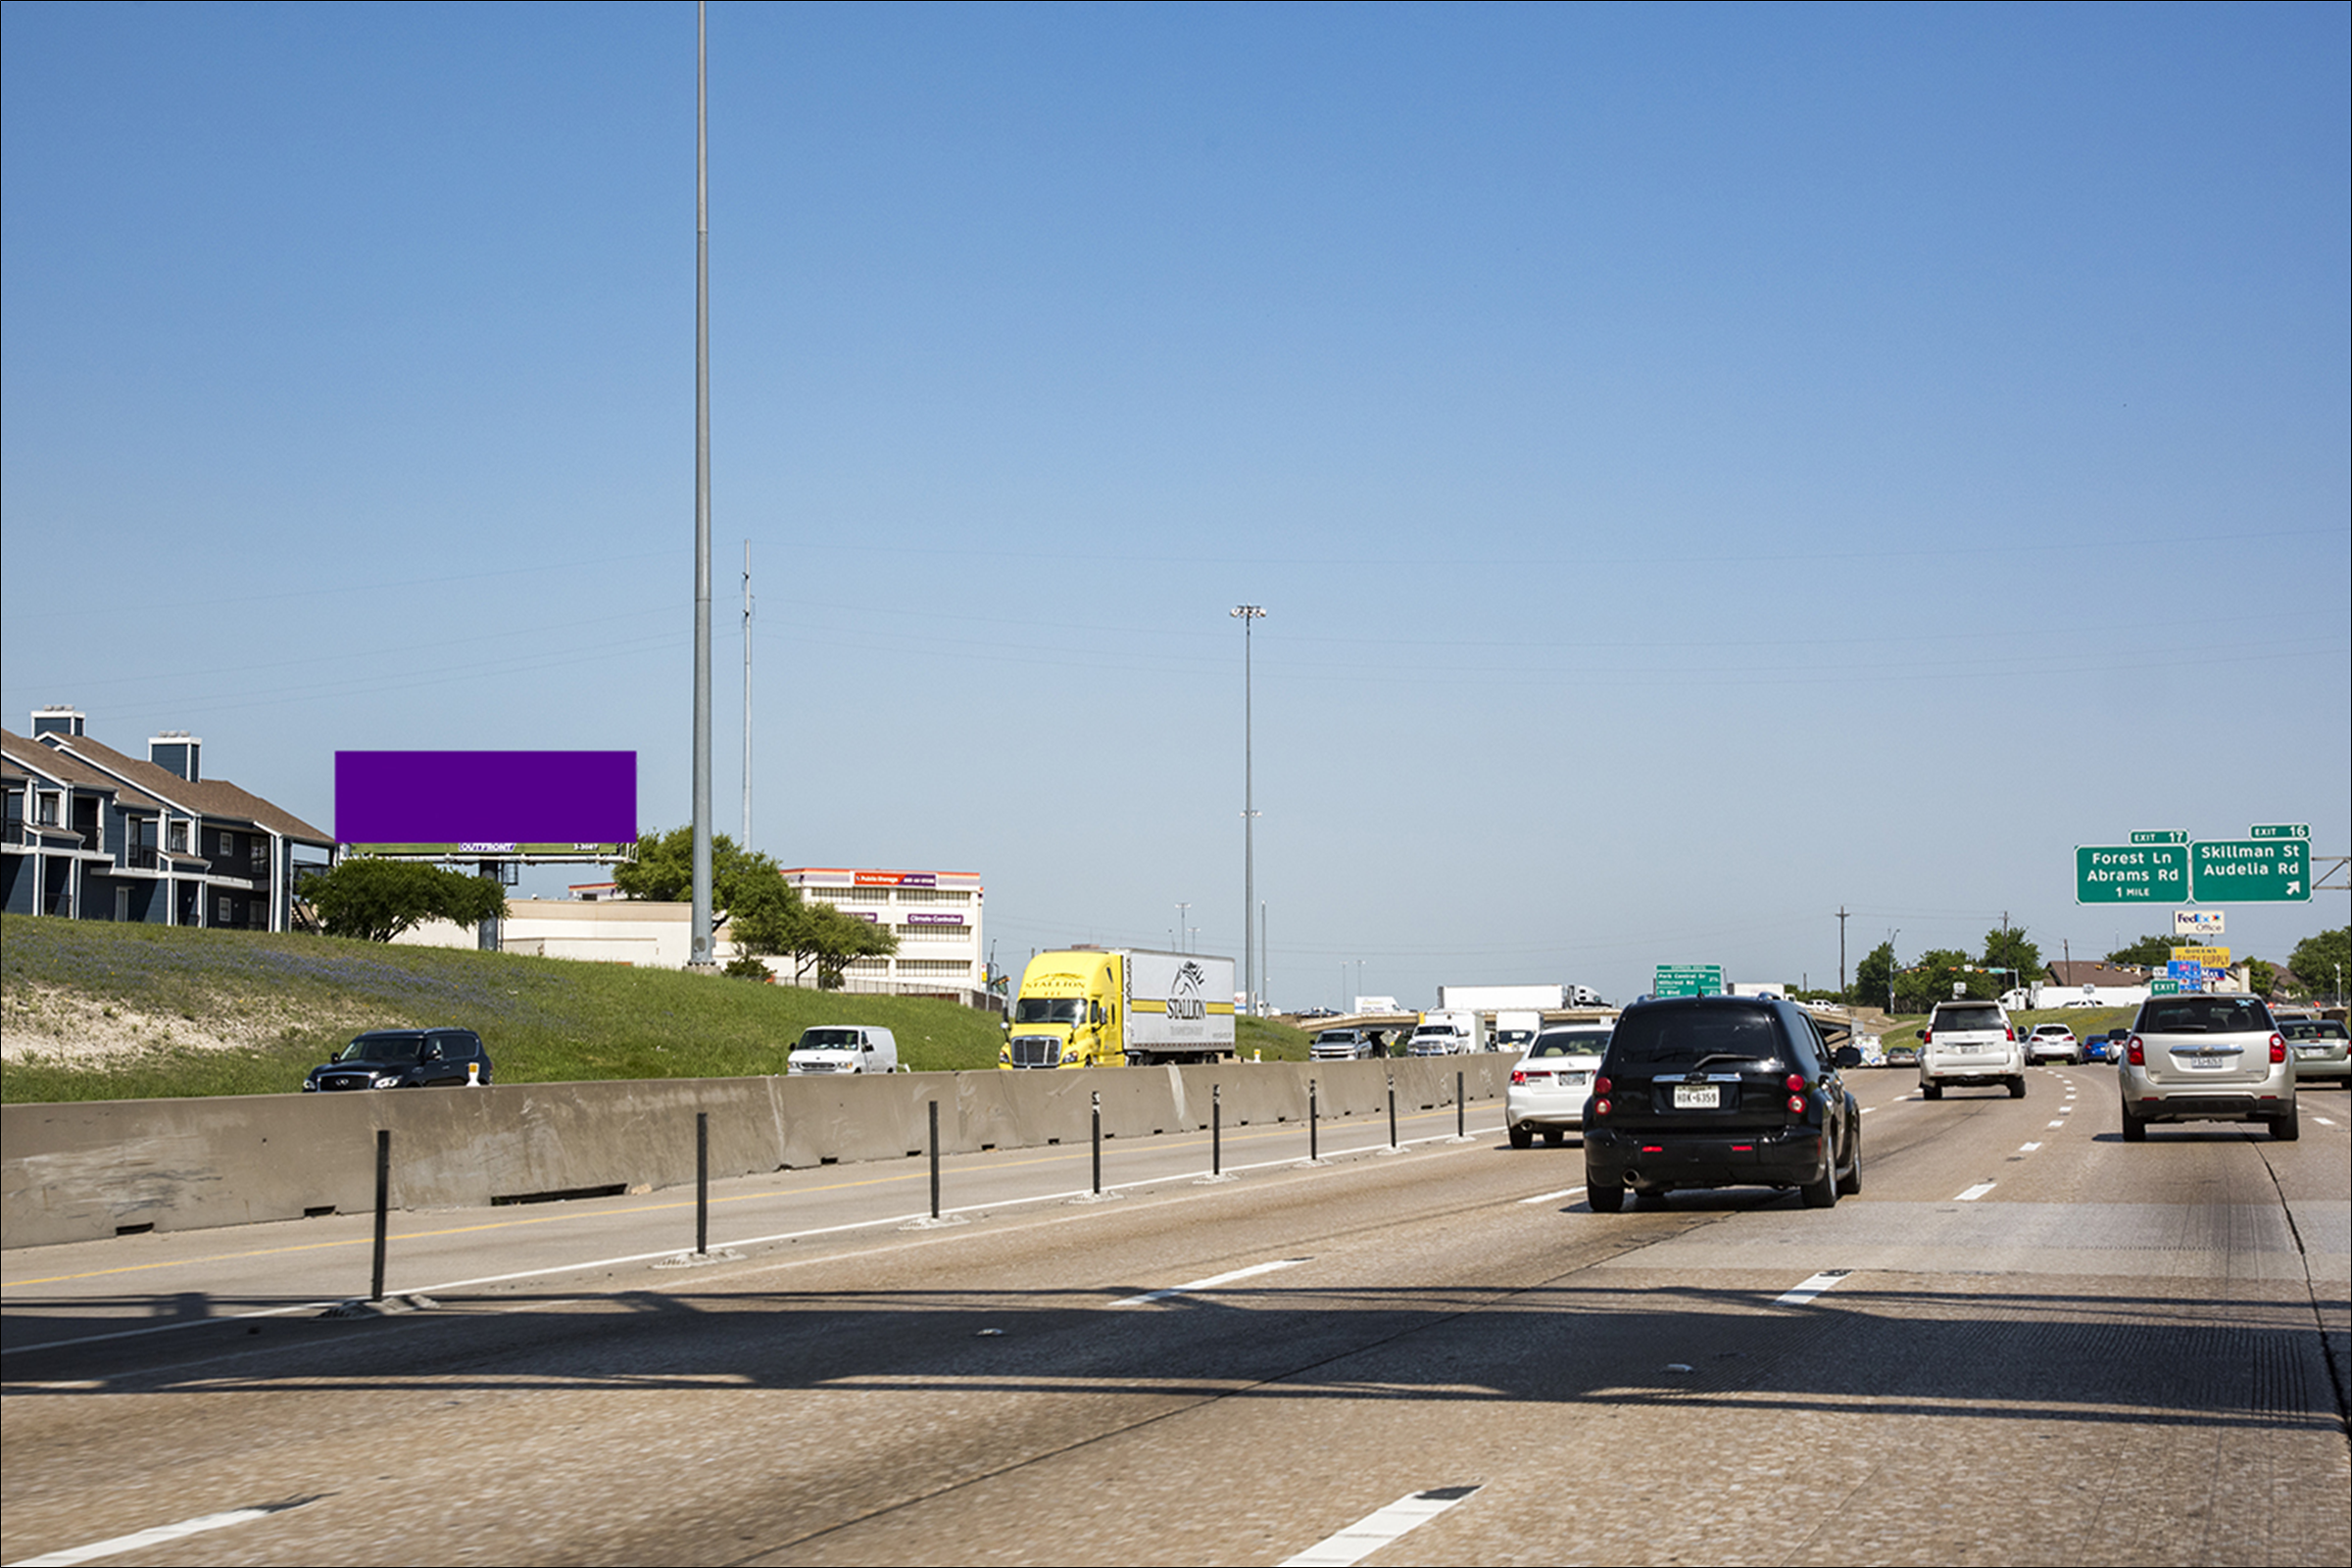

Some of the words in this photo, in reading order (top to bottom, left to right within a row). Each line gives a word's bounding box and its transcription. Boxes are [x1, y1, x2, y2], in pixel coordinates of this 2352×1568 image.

[2289, 825, 2306, 837] 16
[2169, 832, 2183, 843] 17
[2201, 846, 2274, 858] Skillman
[2283, 845, 2300, 858] St
[2092, 853, 2144, 864] Forest
[2153, 853, 2172, 864] Ln
[2204, 862, 2269, 876] Audelia
[2278, 861, 2299, 875] Rd
[2086, 868, 2150, 882] Abrams
[2158, 868, 2179, 882] Rd
[2116, 887, 2122, 898] 1
[2127, 888, 2150, 897] MILE
[2178, 913, 2210, 923] FedEx
[1167, 999, 1206, 1020] STALLION
